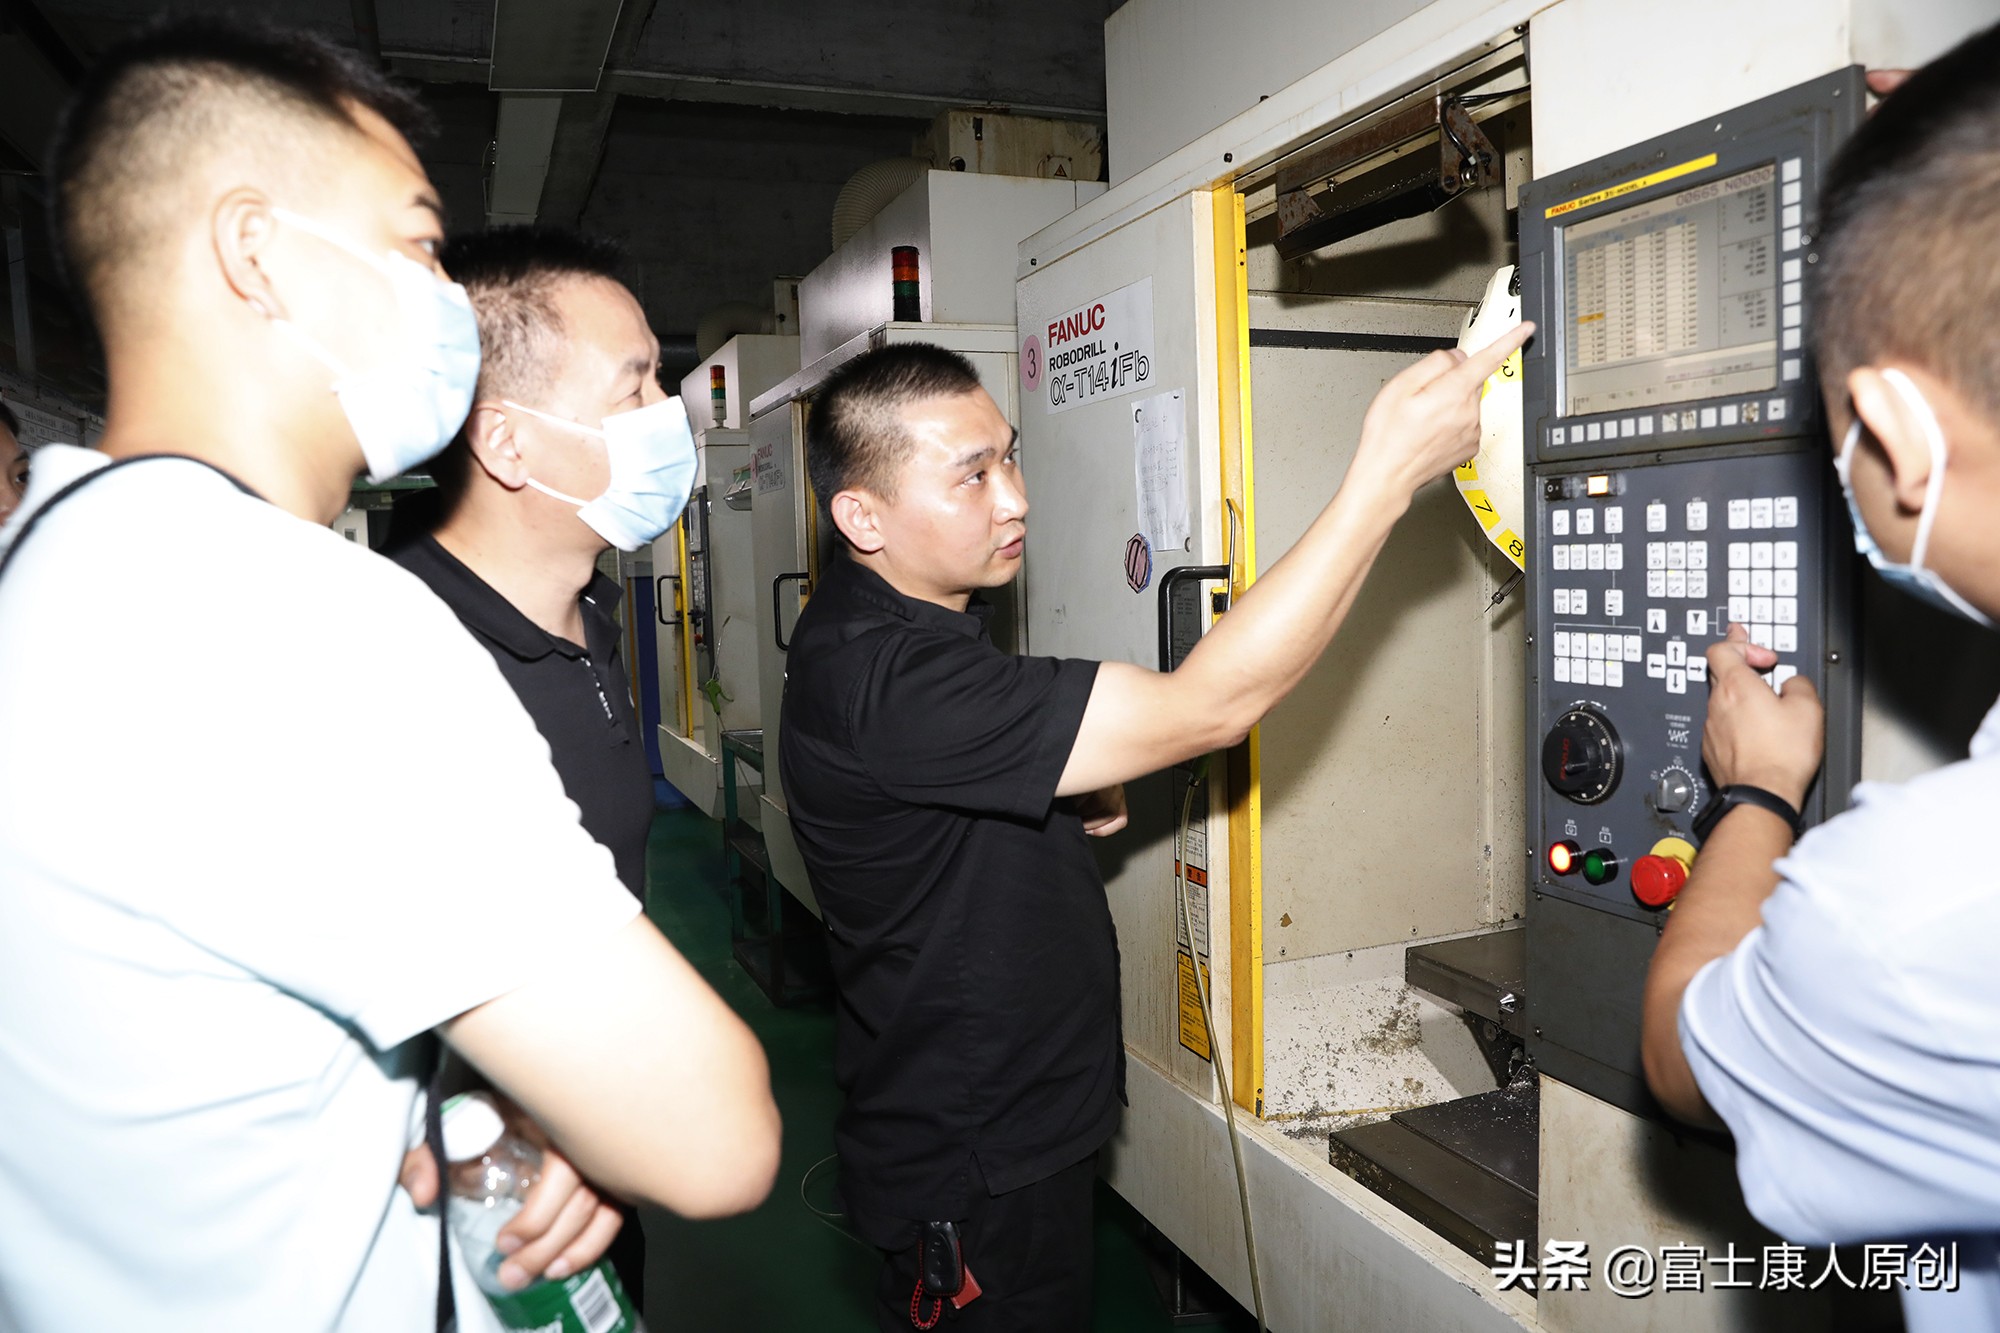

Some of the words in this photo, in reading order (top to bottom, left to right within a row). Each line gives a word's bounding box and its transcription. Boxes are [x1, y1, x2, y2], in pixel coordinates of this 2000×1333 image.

[1551, 202, 1576, 215] FANUC
[1578, 195, 1601, 207] Series
[1048, 303, 1106, 349] FANUC
[1027, 347, 1037, 379] 3
[1049, 340, 1107, 372] ROBODRILL
[1475, 499, 1493, 513] 7
[1509, 539, 1524, 558] 8
